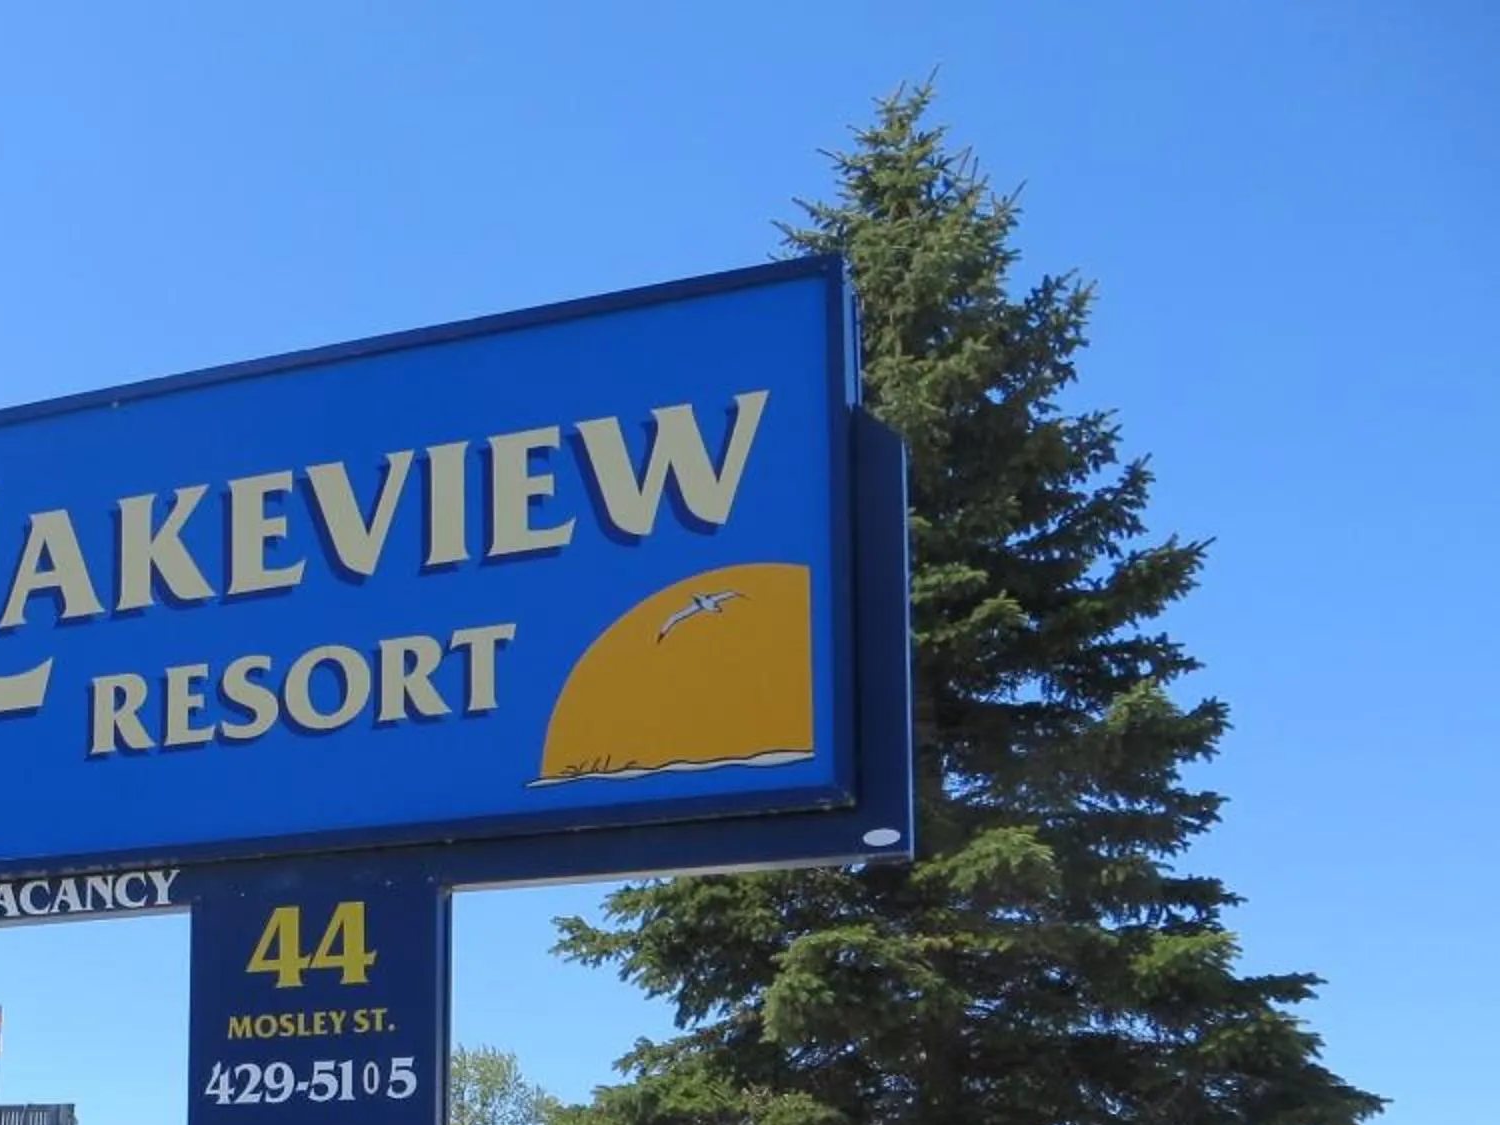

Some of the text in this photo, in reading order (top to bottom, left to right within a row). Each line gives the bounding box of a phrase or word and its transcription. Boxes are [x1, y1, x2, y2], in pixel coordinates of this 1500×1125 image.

[87, 623, 517, 756] RESORT
[246, 901, 377, 988] 44
[227, 1008, 397, 1040] MOSLEY ST.
